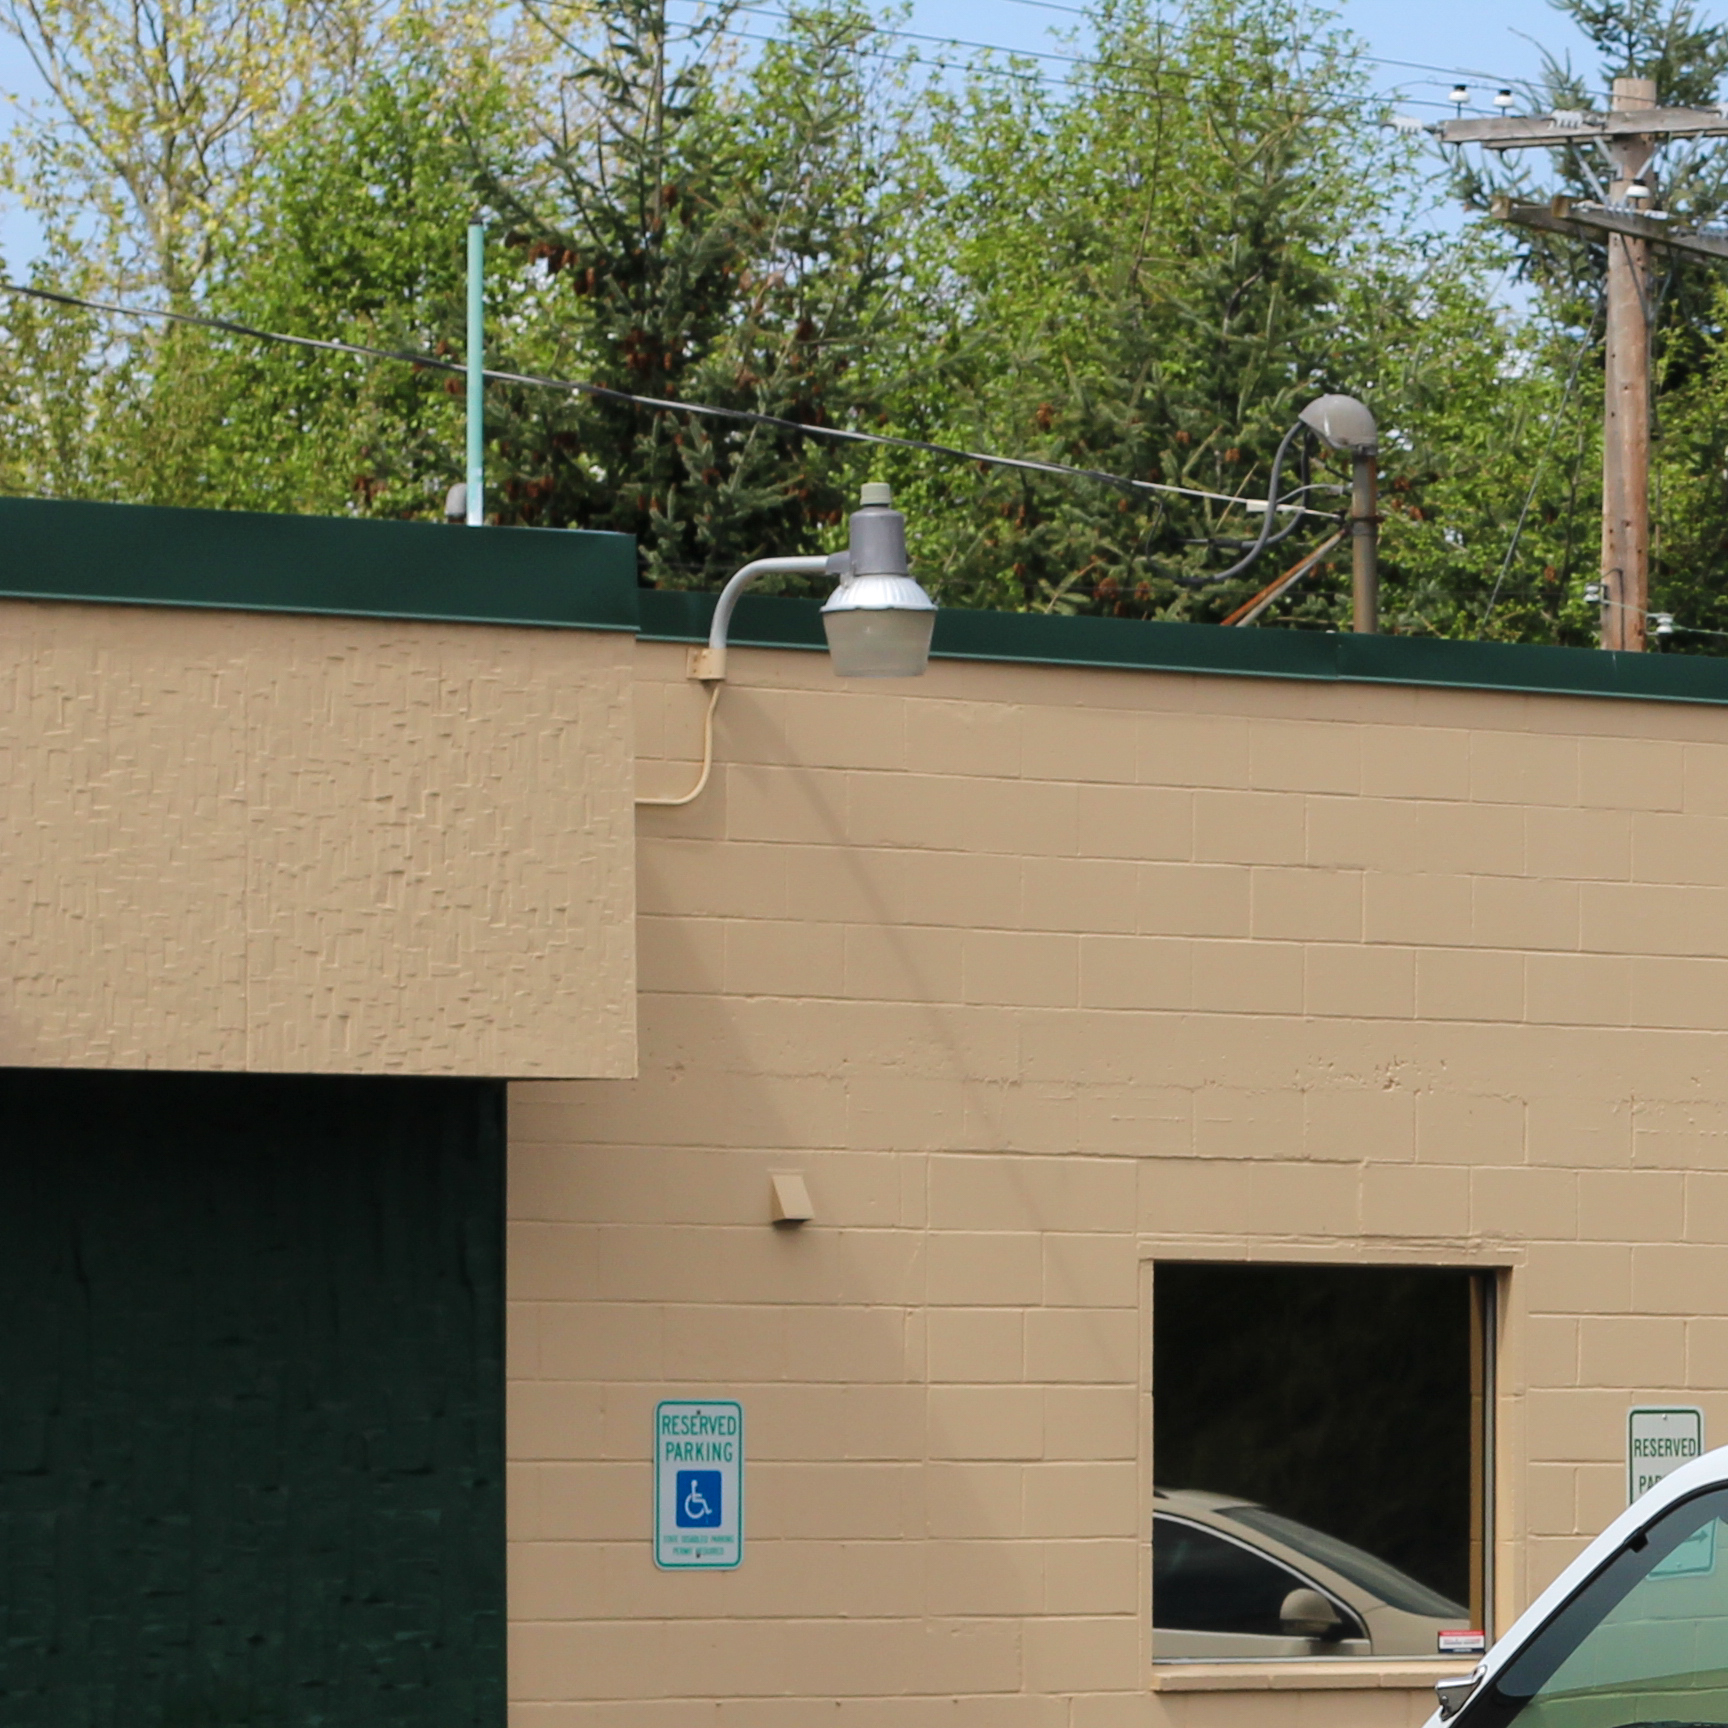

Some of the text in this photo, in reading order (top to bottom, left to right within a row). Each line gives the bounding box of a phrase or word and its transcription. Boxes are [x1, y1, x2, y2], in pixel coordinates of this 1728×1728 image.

[662, 1415, 737, 1436] RESERVED
[665, 1442, 733, 1463] PARKING
[1634, 1438, 1697, 1458] RESERVED
